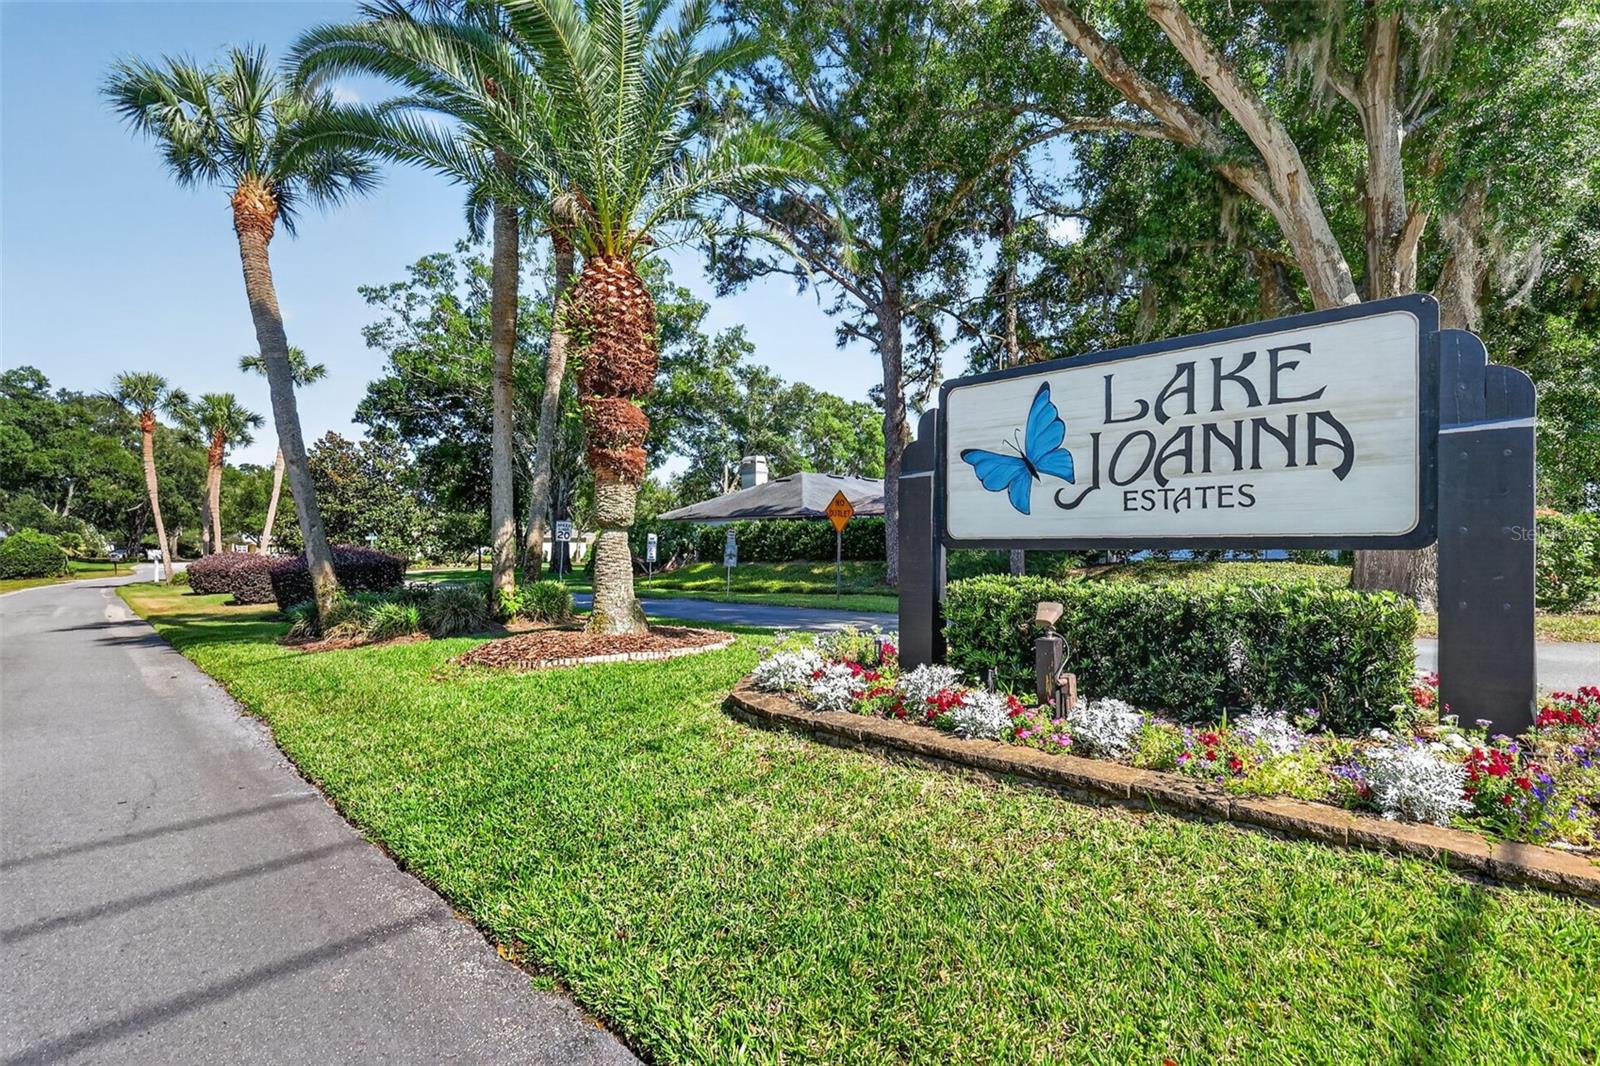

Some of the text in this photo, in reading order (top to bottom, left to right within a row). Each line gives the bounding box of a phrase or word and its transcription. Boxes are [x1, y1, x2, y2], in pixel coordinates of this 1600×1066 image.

[1103, 342, 1327, 425] LAKE
[1054, 410, 1355, 510] JOANNA
[1122, 484, 1257, 513] ESTATES
[557, 531, 570, 539] 20
